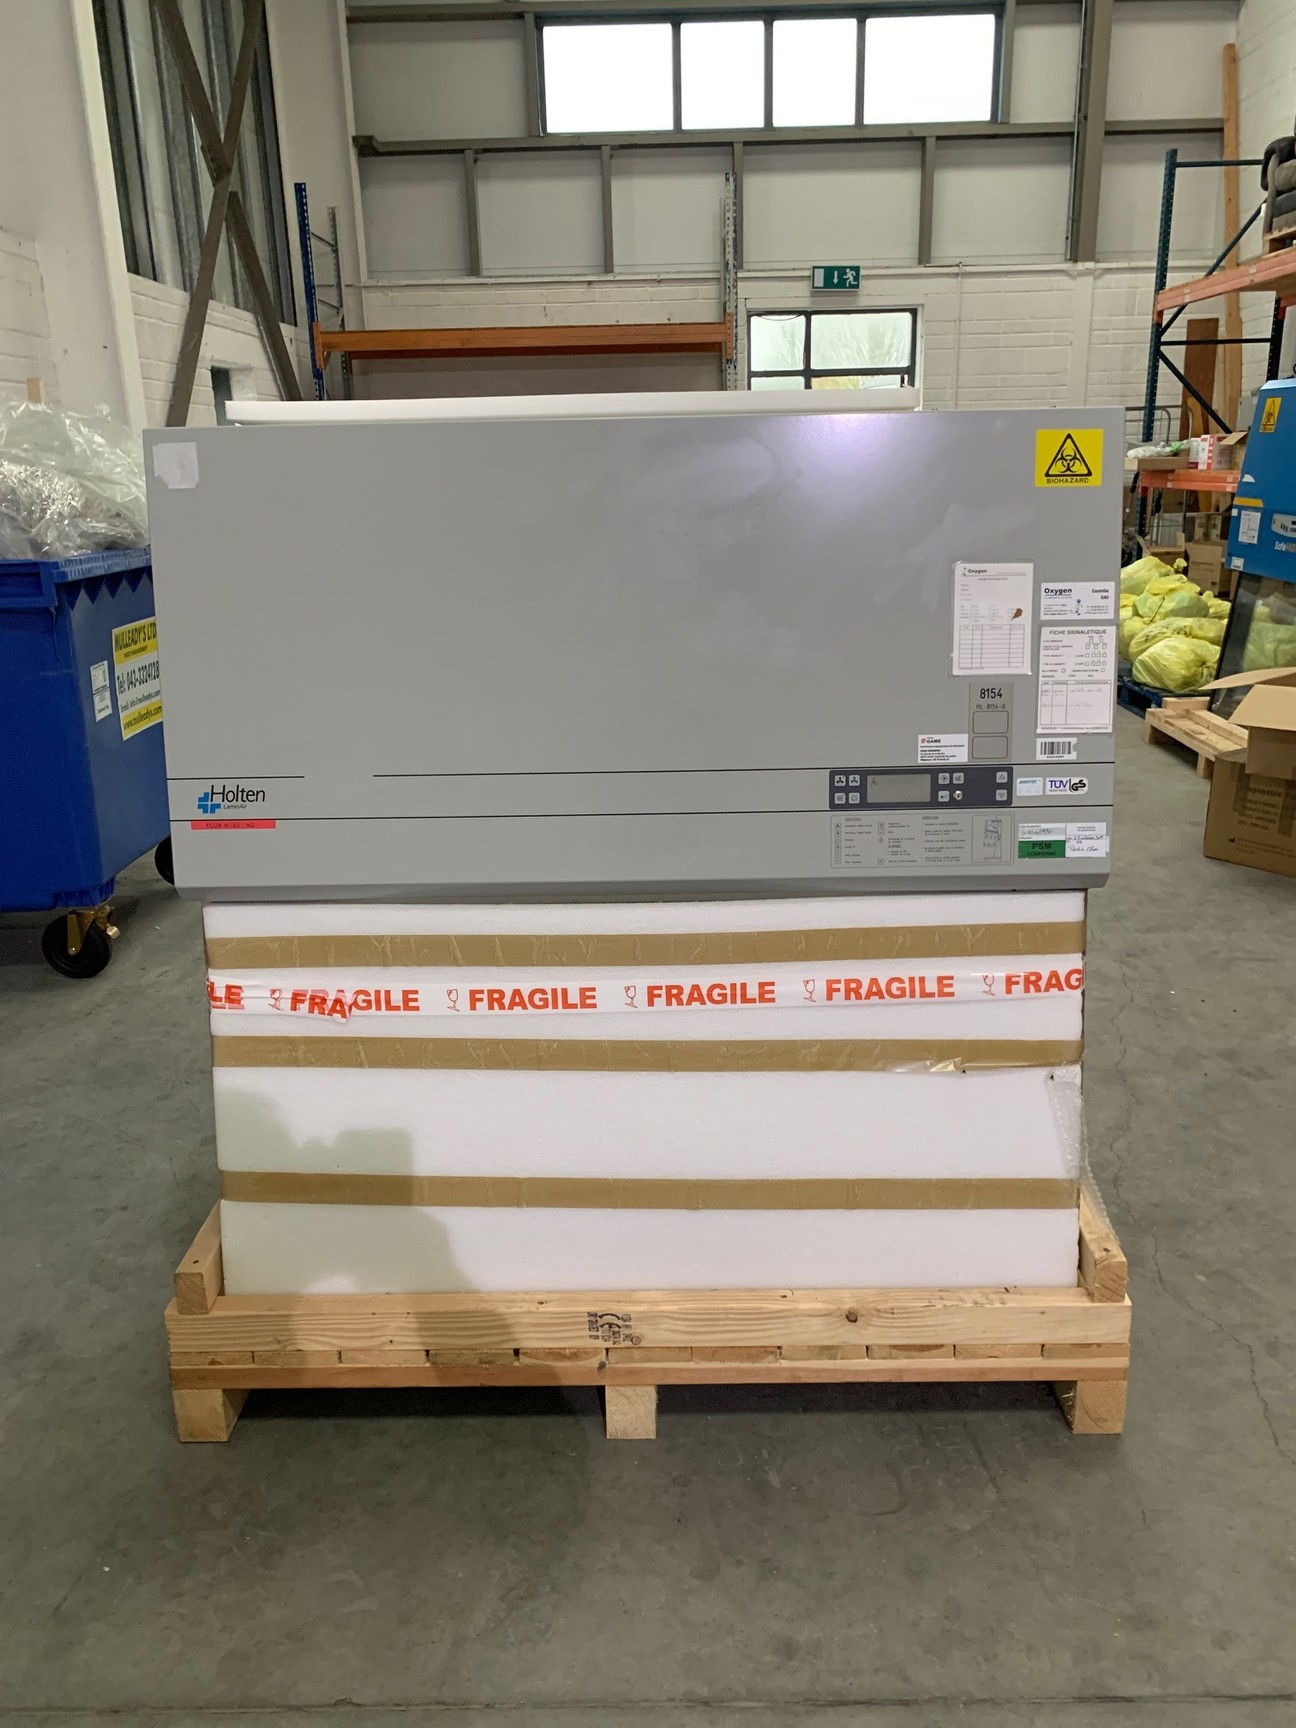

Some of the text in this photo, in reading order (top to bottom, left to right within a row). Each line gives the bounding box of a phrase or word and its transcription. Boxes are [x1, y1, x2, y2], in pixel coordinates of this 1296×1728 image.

[1044, 588, 1072, 596] Oxygen
[147, 621, 157, 640] LTD
[980, 688, 1002, 699] 8154
[1048, 779, 1068, 789] TÜV
[210, 784, 266, 803] Holten
[1032, 842, 1052, 850] PSM
[469, 987, 598, 1011] FRAGILE
[647, 981, 776, 1007] FRAGILE
[826, 975, 955, 1001] FRAGILE
[1004, 968, 1083, 995] FRAG
